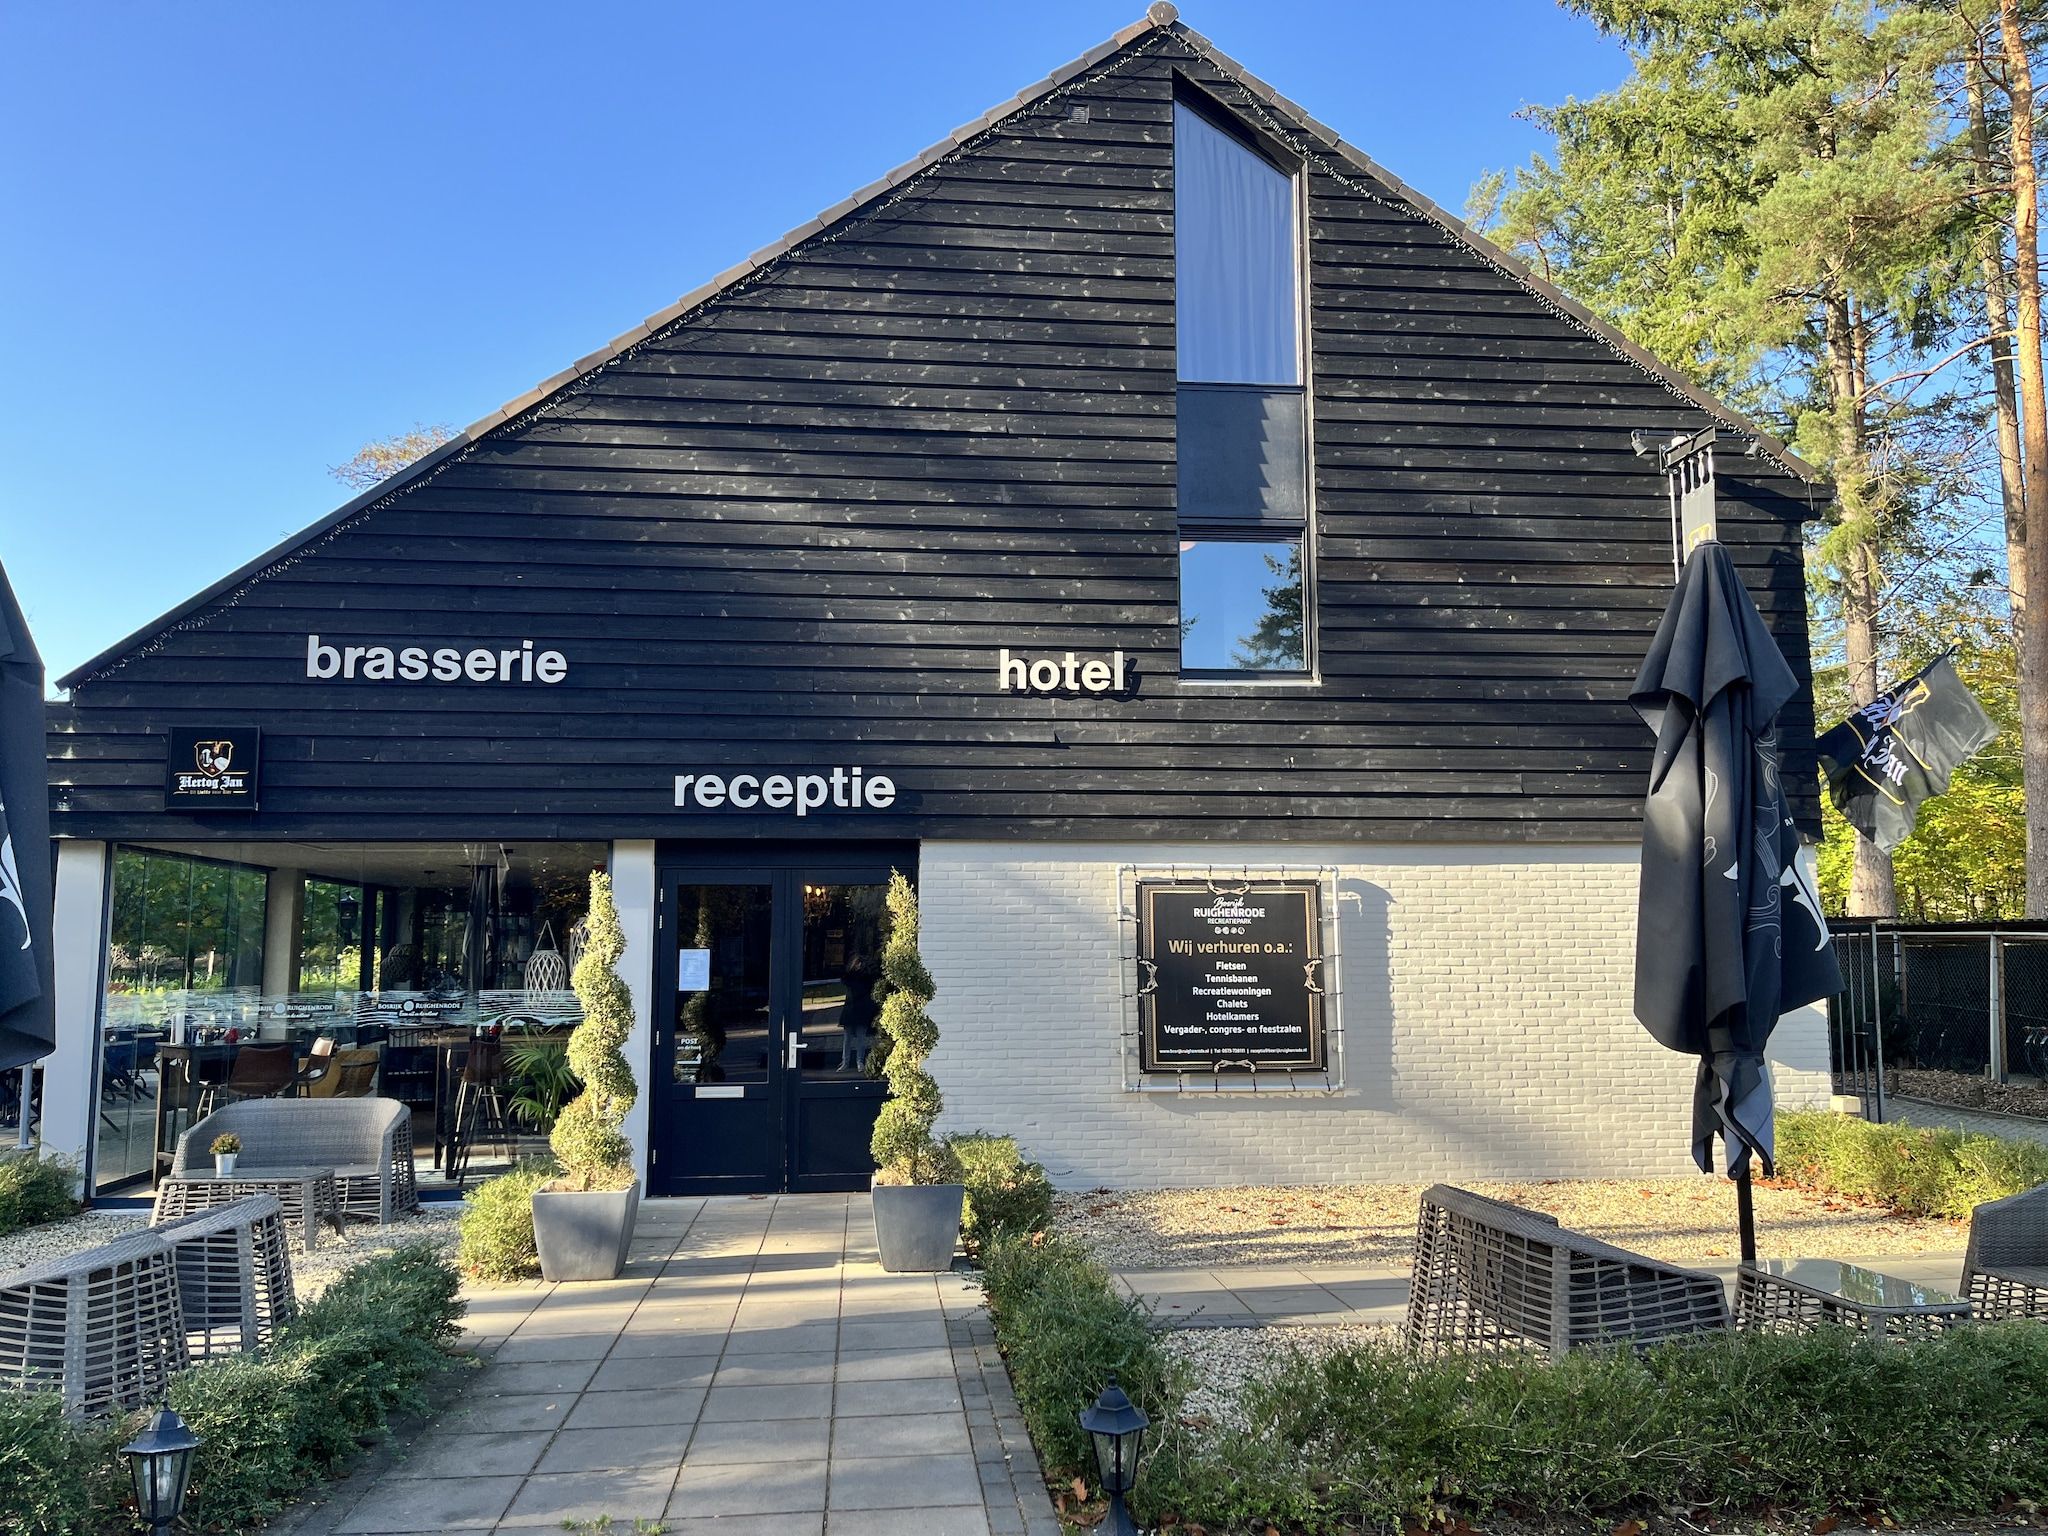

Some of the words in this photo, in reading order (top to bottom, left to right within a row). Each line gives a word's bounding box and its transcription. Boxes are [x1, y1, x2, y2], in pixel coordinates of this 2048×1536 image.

[306, 634, 568, 684] brasserie
[999, 648, 1125, 692] hotel
[178, 775, 220, 791] Hertog
[219, 775, 244, 791] Jan
[673, 766, 897, 817] receptie
[1193, 907, 1266, 918] RUIGHENRODE
[1207, 917, 1252, 925] RECREATIEPARK
[1168, 940, 1194, 956] Wij
[1197, 940, 1260, 954] verhuren
[1216, 961, 1247, 971] Fietsen
[1204, 974, 1258, 983] Tennisbanen
[1192, 986, 1272, 998] Recreatiewoningen
[1216, 999, 1249, 1009] Chalets
[1206, 1012, 1260, 1021] Hotelkamers
[1209, 1026, 1246, 1036] congres-
[1246, 1026, 1258, 1034] en
[1259, 1024, 1302, 1034] feestzalen
